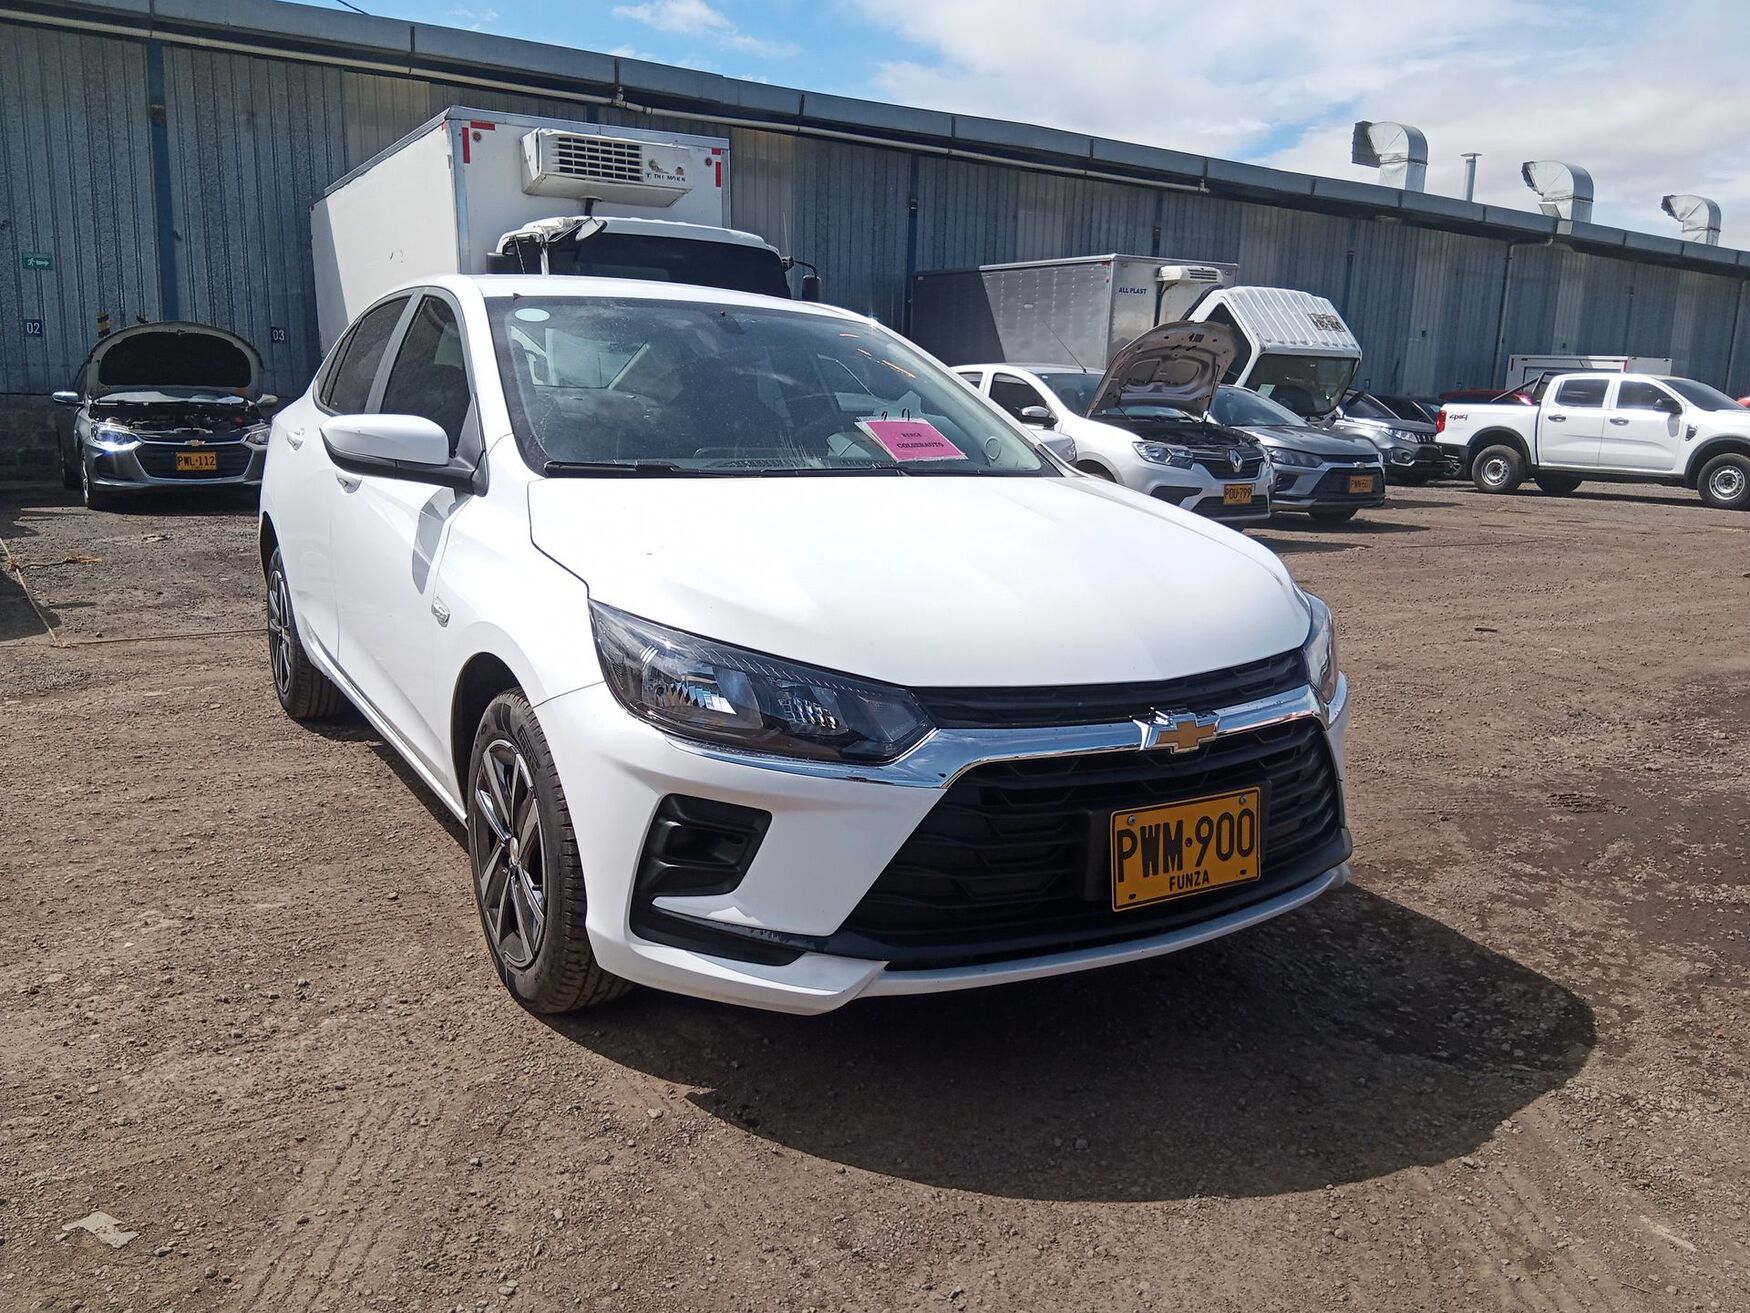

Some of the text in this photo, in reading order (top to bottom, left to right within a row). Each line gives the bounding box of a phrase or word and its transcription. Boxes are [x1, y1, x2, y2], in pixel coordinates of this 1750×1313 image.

[26, 322, 41, 334] 02
[272, 329, 285, 341] 03
[1169, 869, 1210, 892] FUNZA
